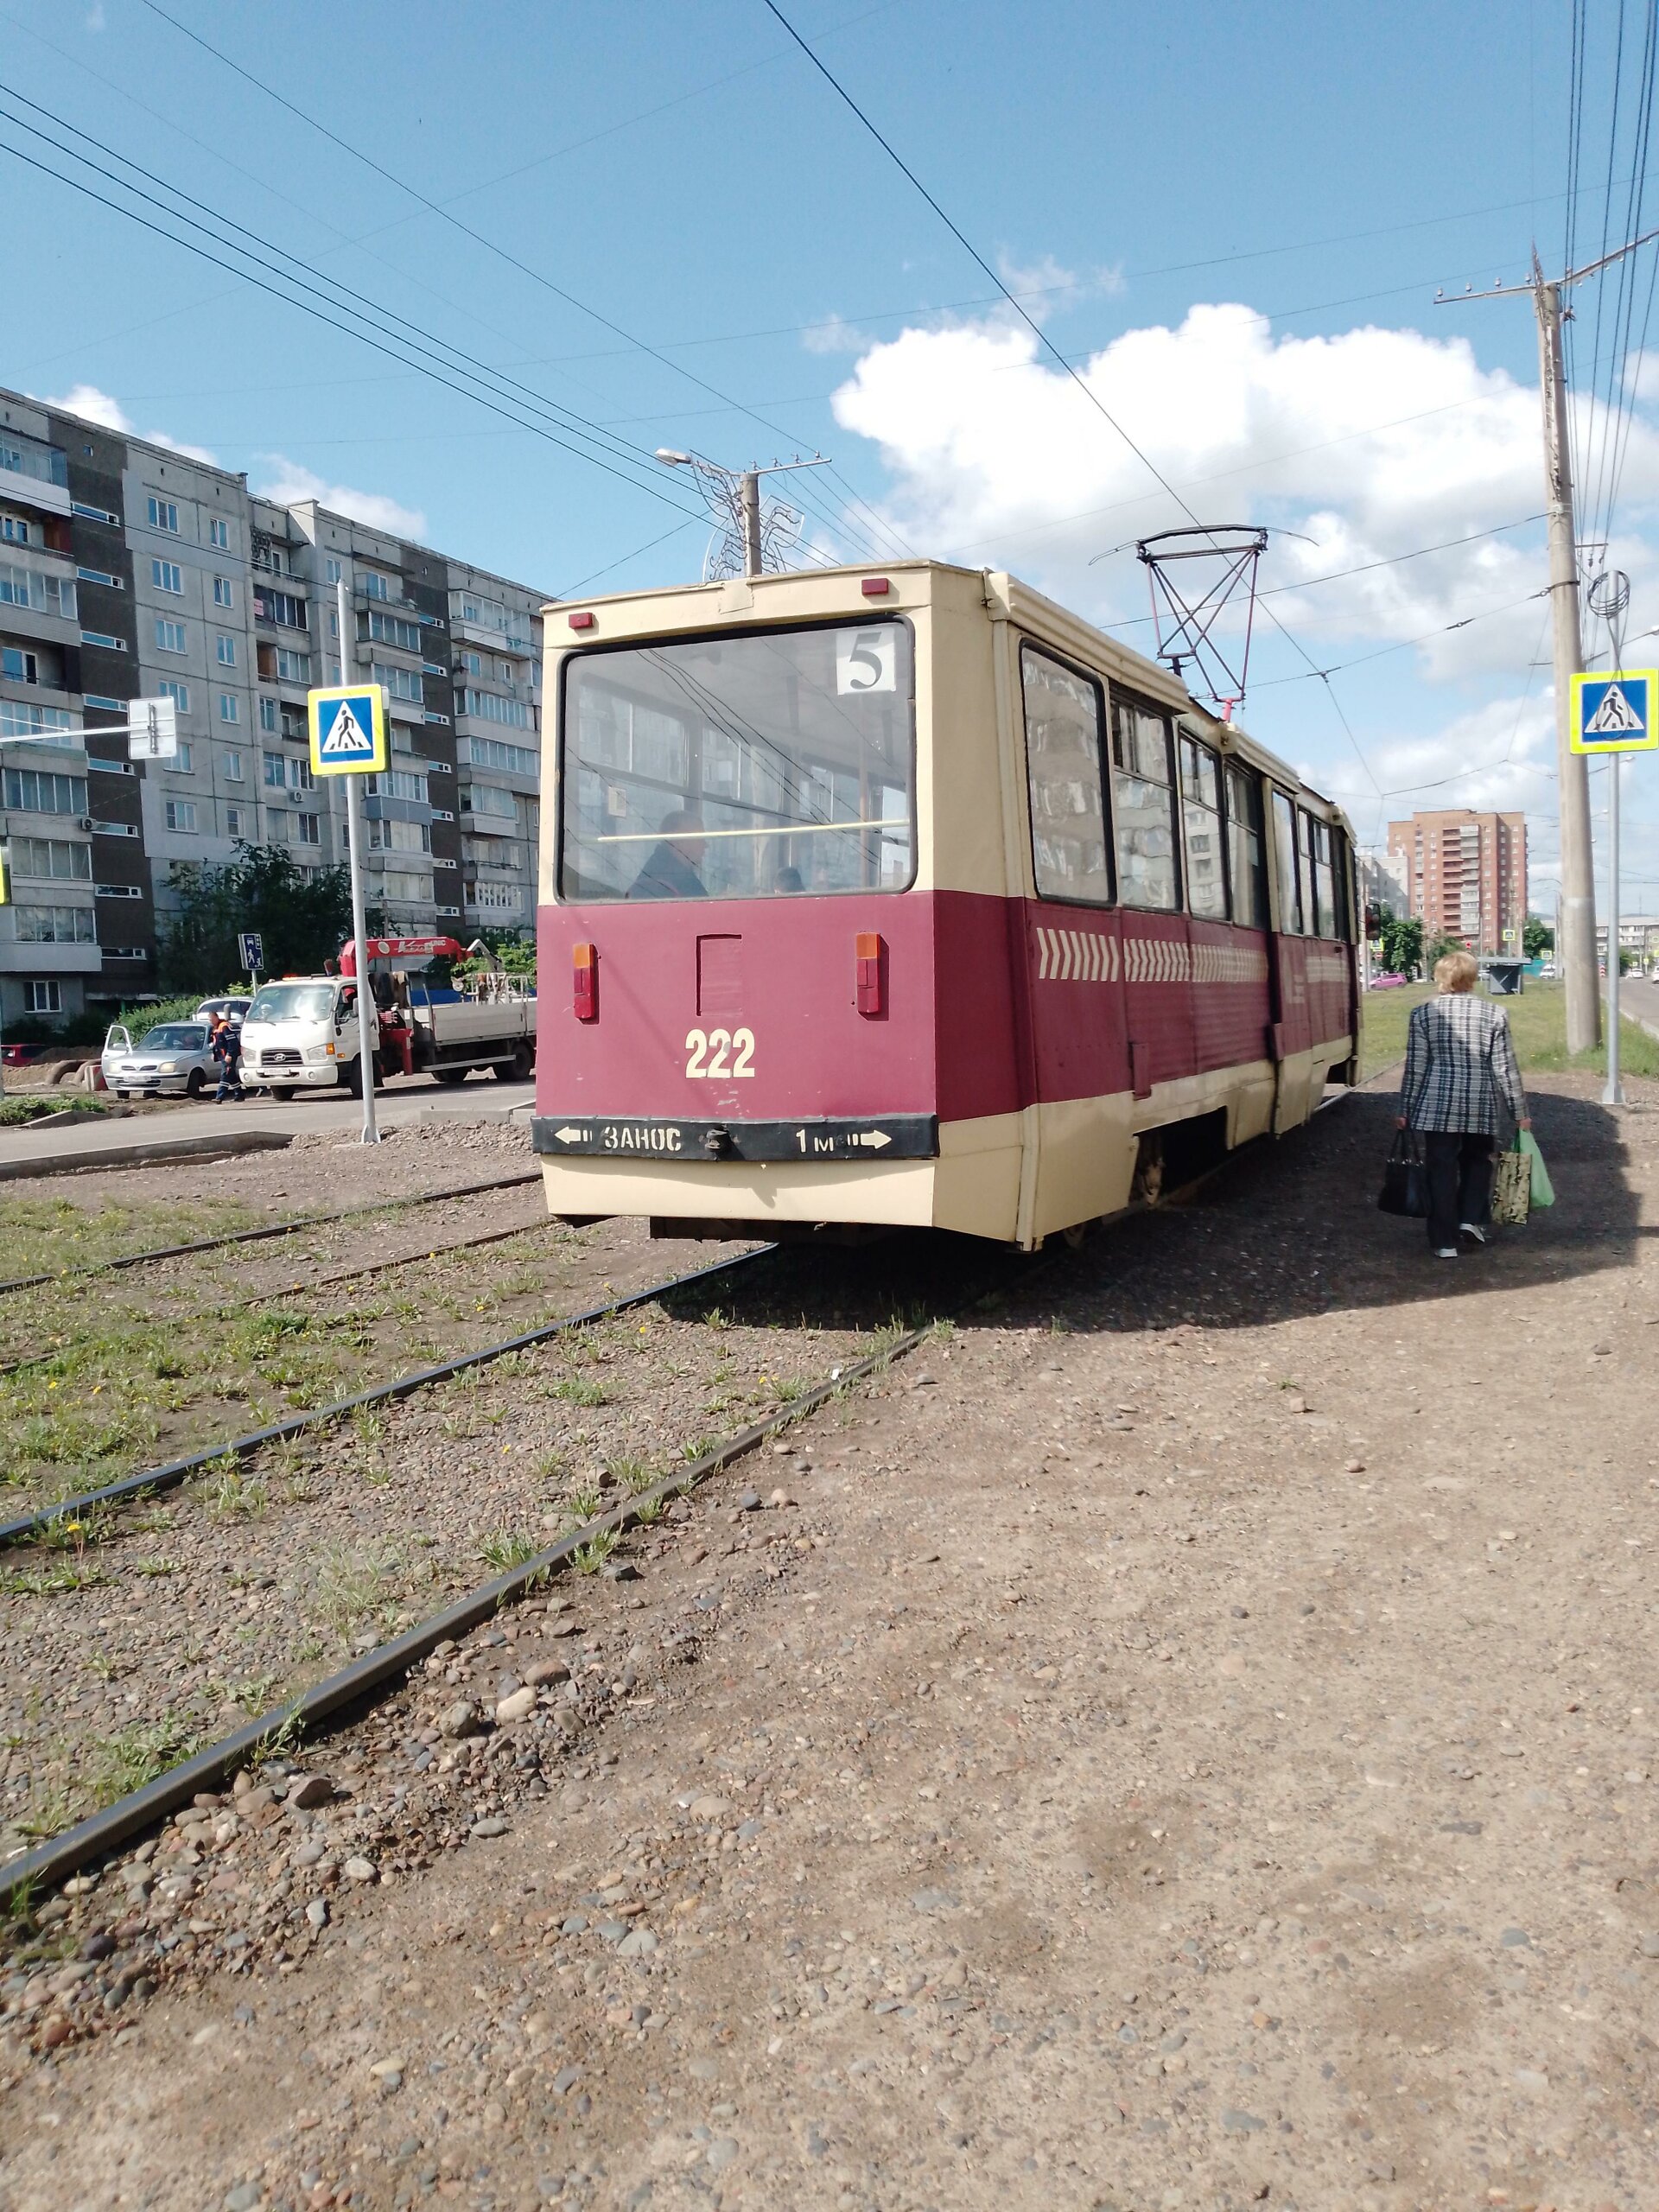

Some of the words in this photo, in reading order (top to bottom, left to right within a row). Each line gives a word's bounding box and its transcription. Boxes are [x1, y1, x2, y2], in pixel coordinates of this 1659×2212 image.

[849, 631, 882, 690] 5
[685, 1027, 755, 1078] 222
[604, 1126, 682, 1151] ЗАНОС
[796, 1128, 806, 1153] 1
